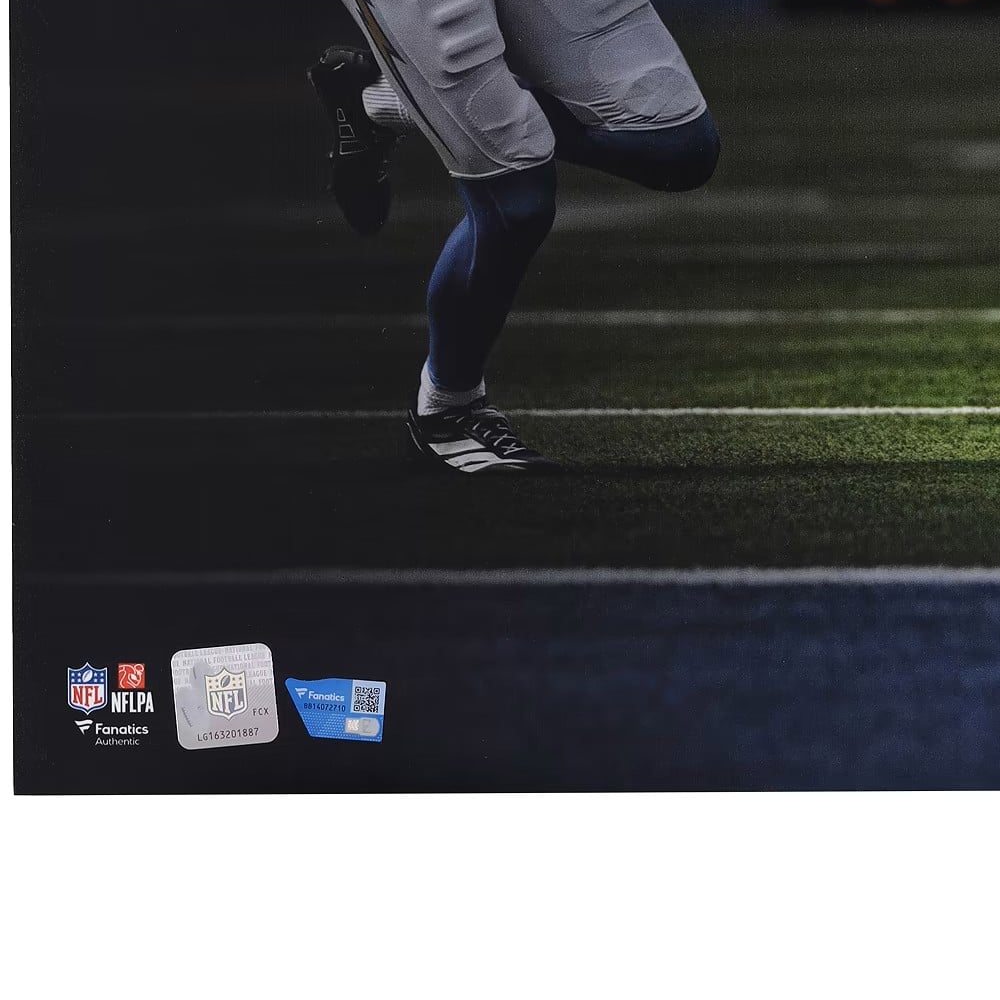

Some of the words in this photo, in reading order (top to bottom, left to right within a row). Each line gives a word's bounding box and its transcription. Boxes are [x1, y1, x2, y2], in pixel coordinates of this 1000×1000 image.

[72, 685, 103, 707] NFL
[111, 691, 155, 713] NFLPA
[210, 690, 244, 714] NFL
[308, 690, 345, 702] Fanatics
[252, 707, 269, 716] FCX
[95, 722, 149, 735] Fanatics
[197, 727, 259, 742] LG163201887
[94, 736, 140, 746] Authentic
